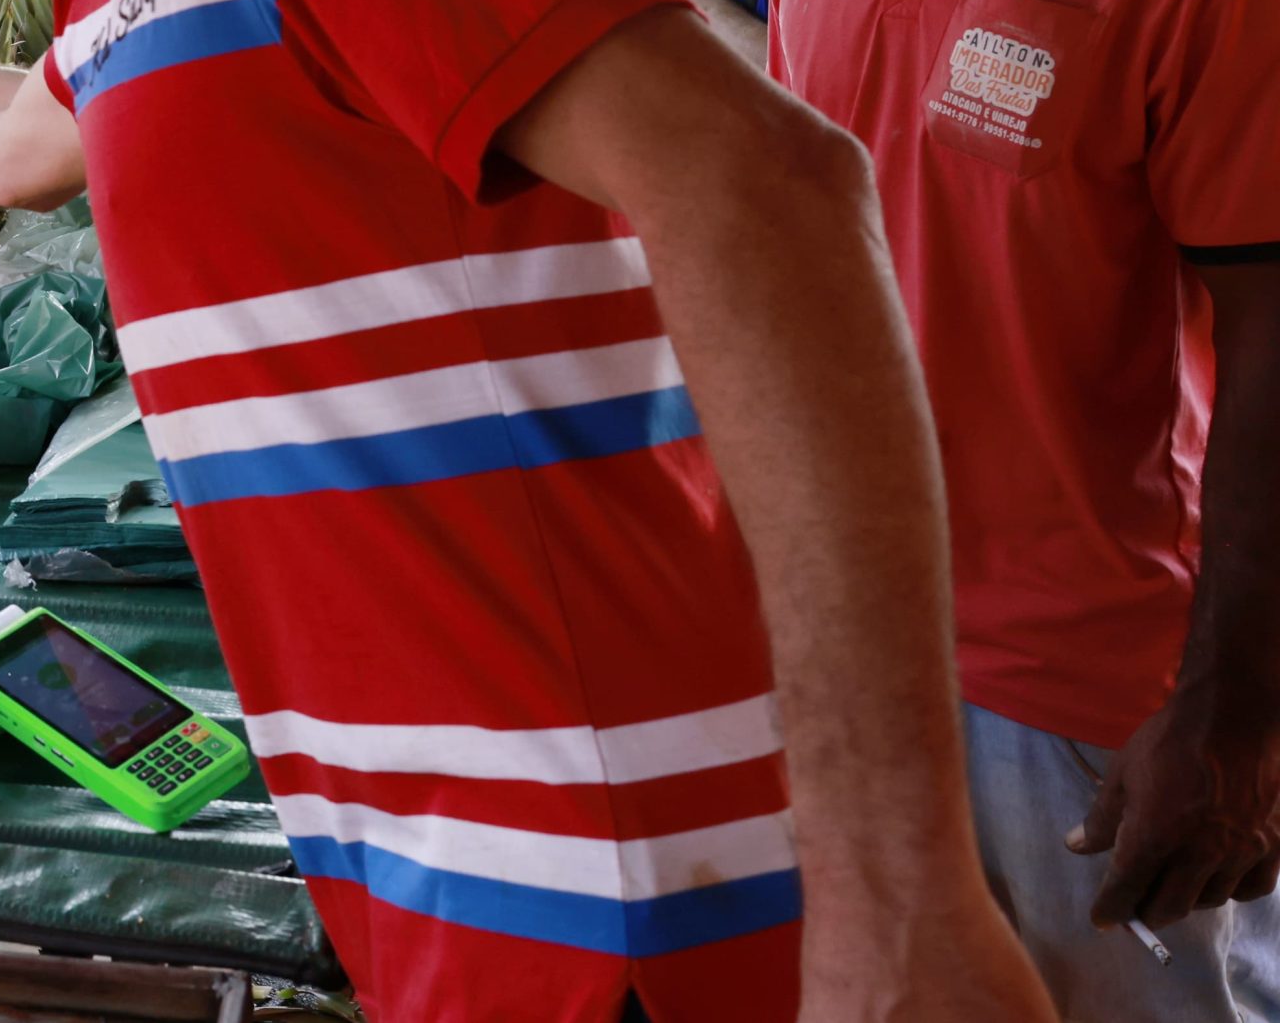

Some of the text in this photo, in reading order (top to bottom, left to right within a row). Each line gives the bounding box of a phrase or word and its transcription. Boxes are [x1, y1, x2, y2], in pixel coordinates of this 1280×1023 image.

[954, 45, 1050, 94] IMPERADOR
[969, 33, 1045, 68] AILTON
[953, 69, 1033, 111] Das Frutas
[942, 91, 1027, 132] ATACADO E VAREJO
